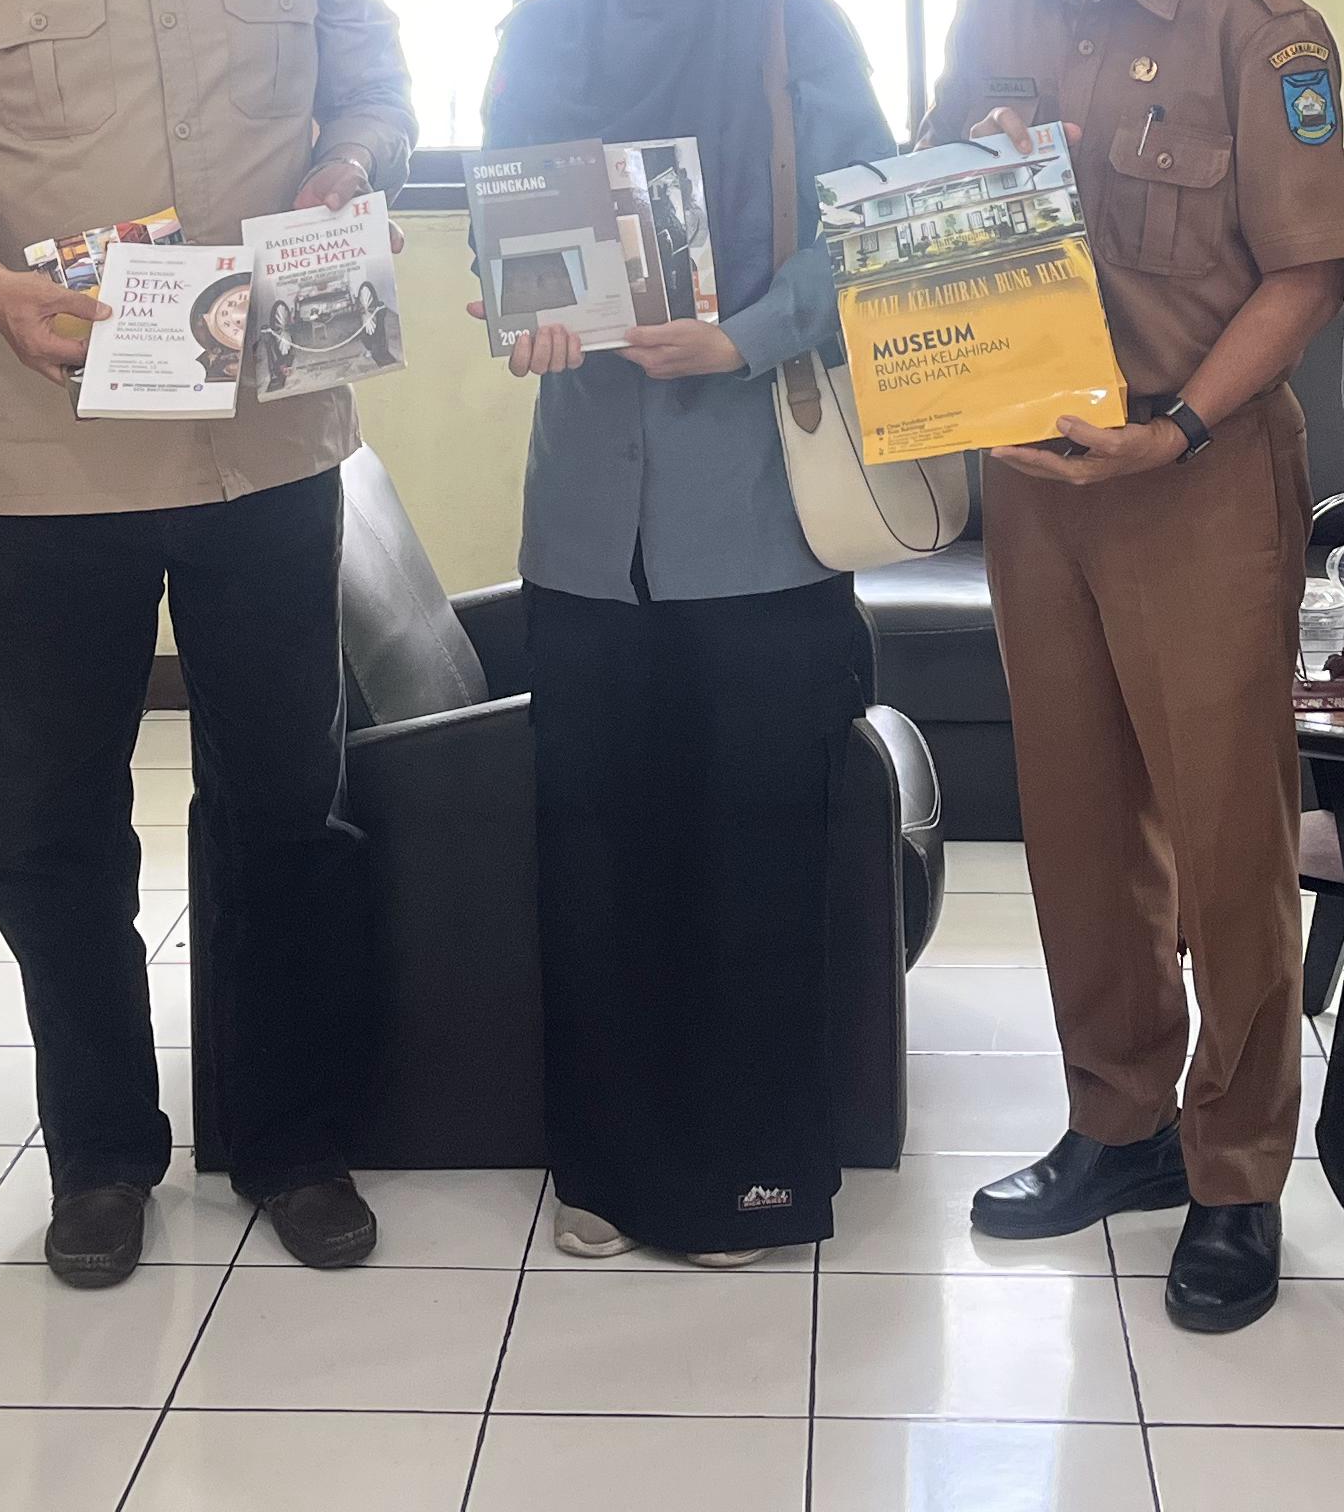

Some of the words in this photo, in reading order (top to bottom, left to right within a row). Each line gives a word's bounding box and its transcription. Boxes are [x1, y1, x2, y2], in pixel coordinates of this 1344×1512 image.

[473, 161, 523, 179] SONGKET
[475, 176, 547, 196] SILUNGKANG
[907, 278, 990, 313] KELAHIRAN
[995, 267, 1032, 294] BUNG
[873, 322, 976, 361] MUSEUM
[875, 356, 928, 377] RUMAH
[931, 337, 1011, 365] KELAHIRAN
[878, 371, 922, 392] BUNG
[924, 362, 972, 382] HATTA
